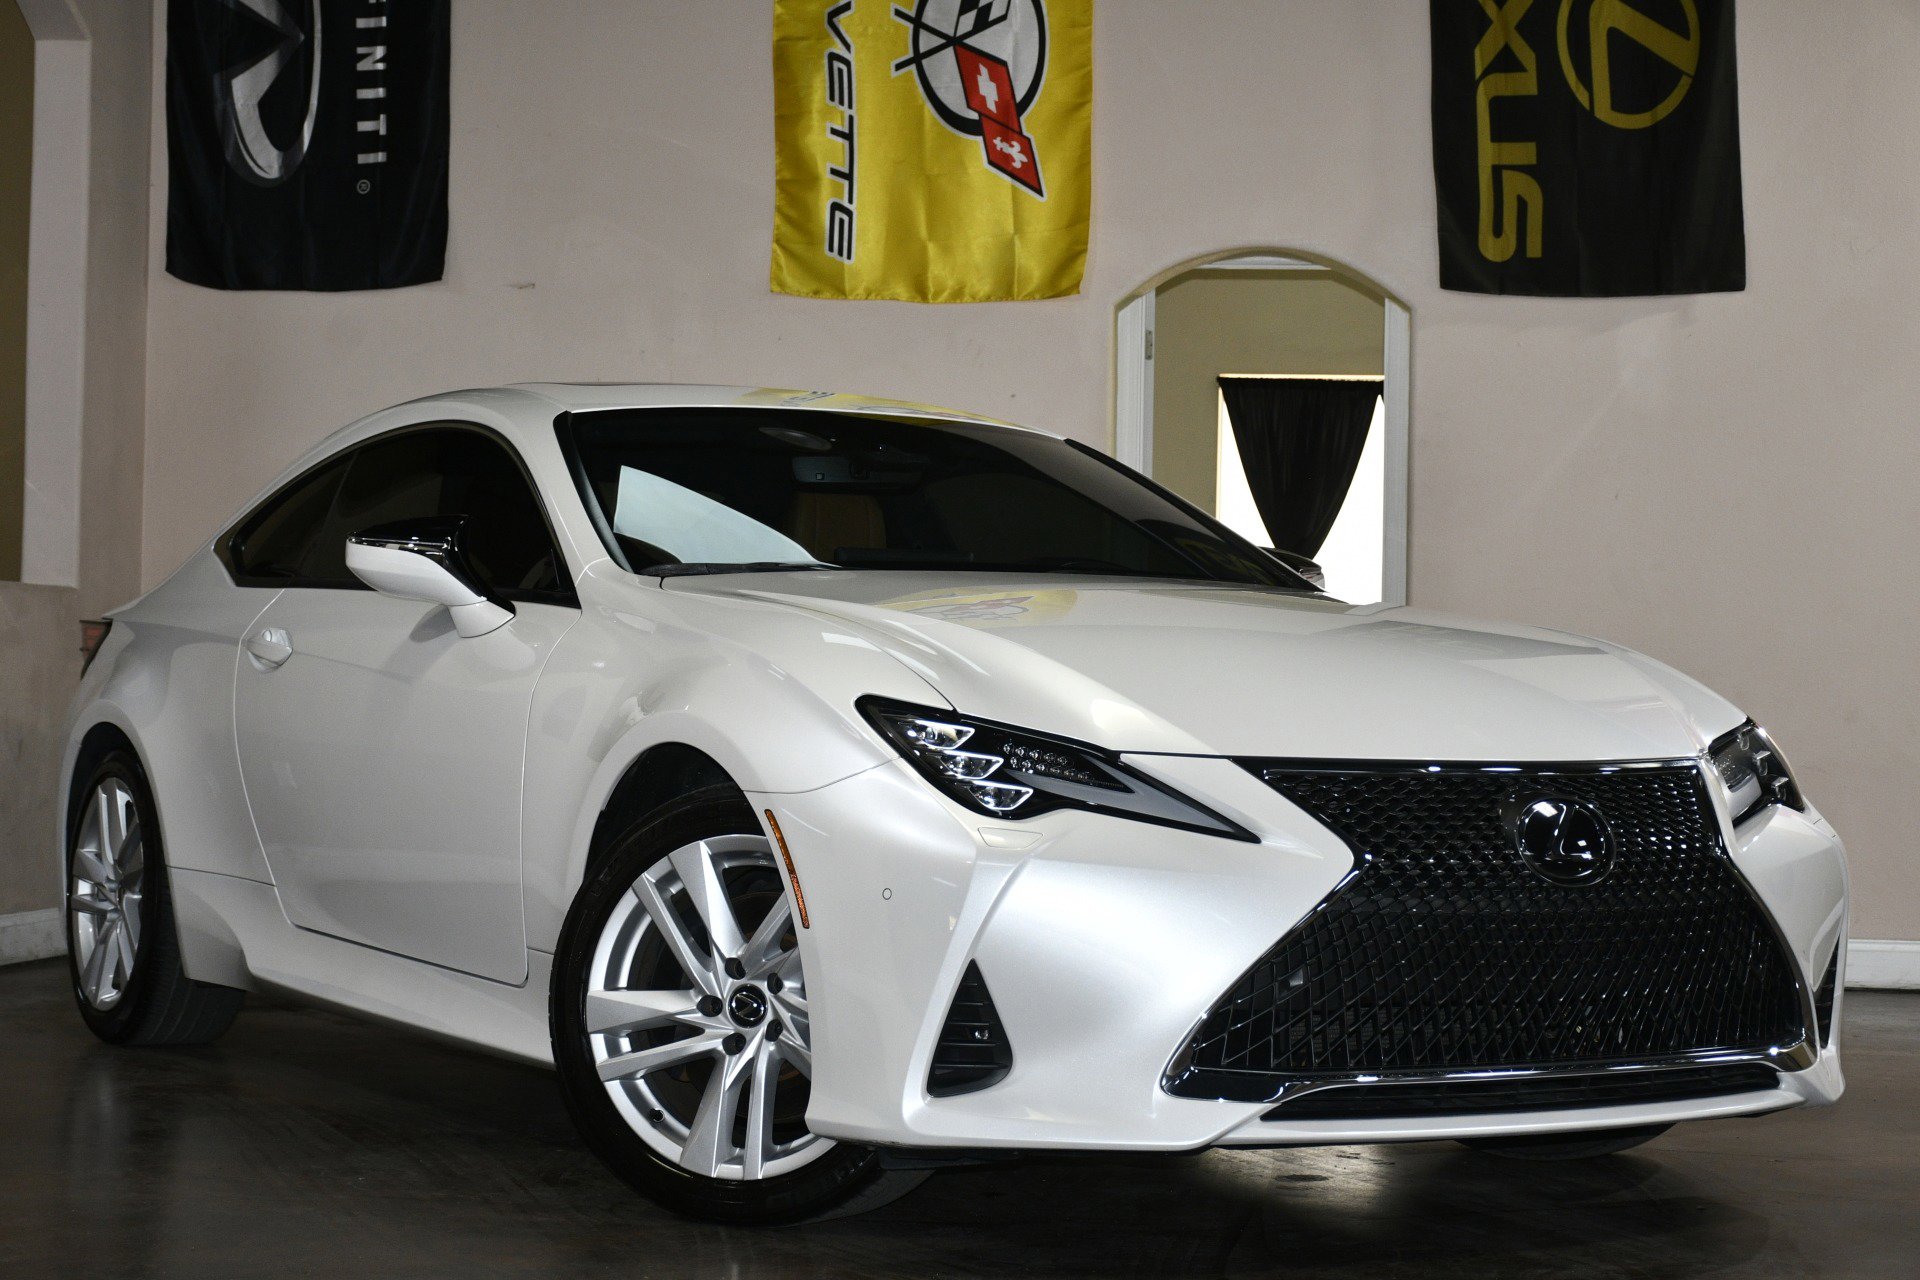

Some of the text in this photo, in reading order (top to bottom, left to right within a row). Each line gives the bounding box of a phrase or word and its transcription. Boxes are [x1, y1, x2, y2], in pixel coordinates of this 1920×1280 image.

[356, 0, 387, 165] INITI
[825, 0, 855, 262] VETTE
[1474, 0, 1543, 263] XUS
